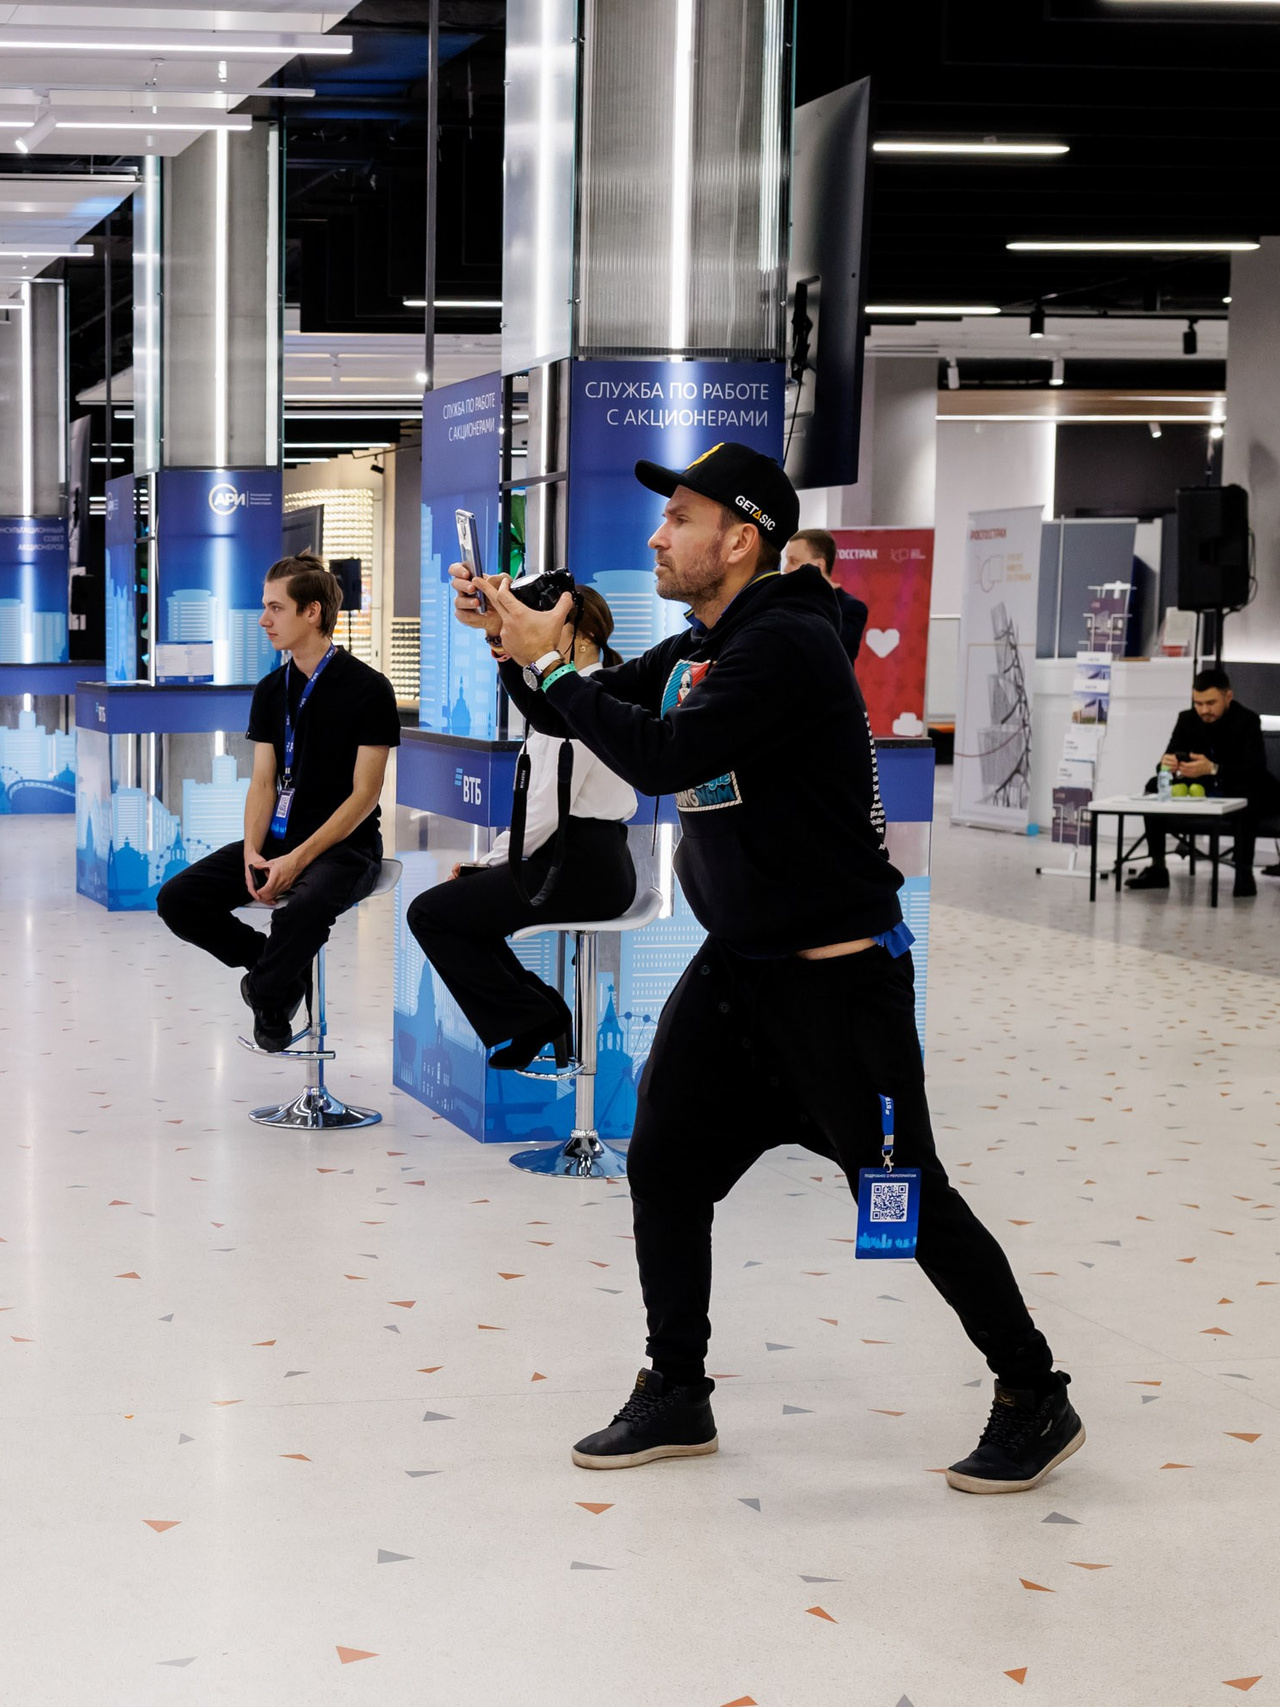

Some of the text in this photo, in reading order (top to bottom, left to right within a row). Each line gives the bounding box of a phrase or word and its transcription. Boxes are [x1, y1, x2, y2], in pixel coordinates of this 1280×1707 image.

[585, 381, 770, 400] СЛУЖБА ПО РАБОТЕ
[443, 392, 496, 419] СЛУЖБА ПО РАБОТЕ
[448, 417, 495, 442] С АКЦИОНЕРАМИ
[606, 408, 768, 429] С АКЦИОНЕРАМИ
[463, 775, 482, 806] ВТБ
